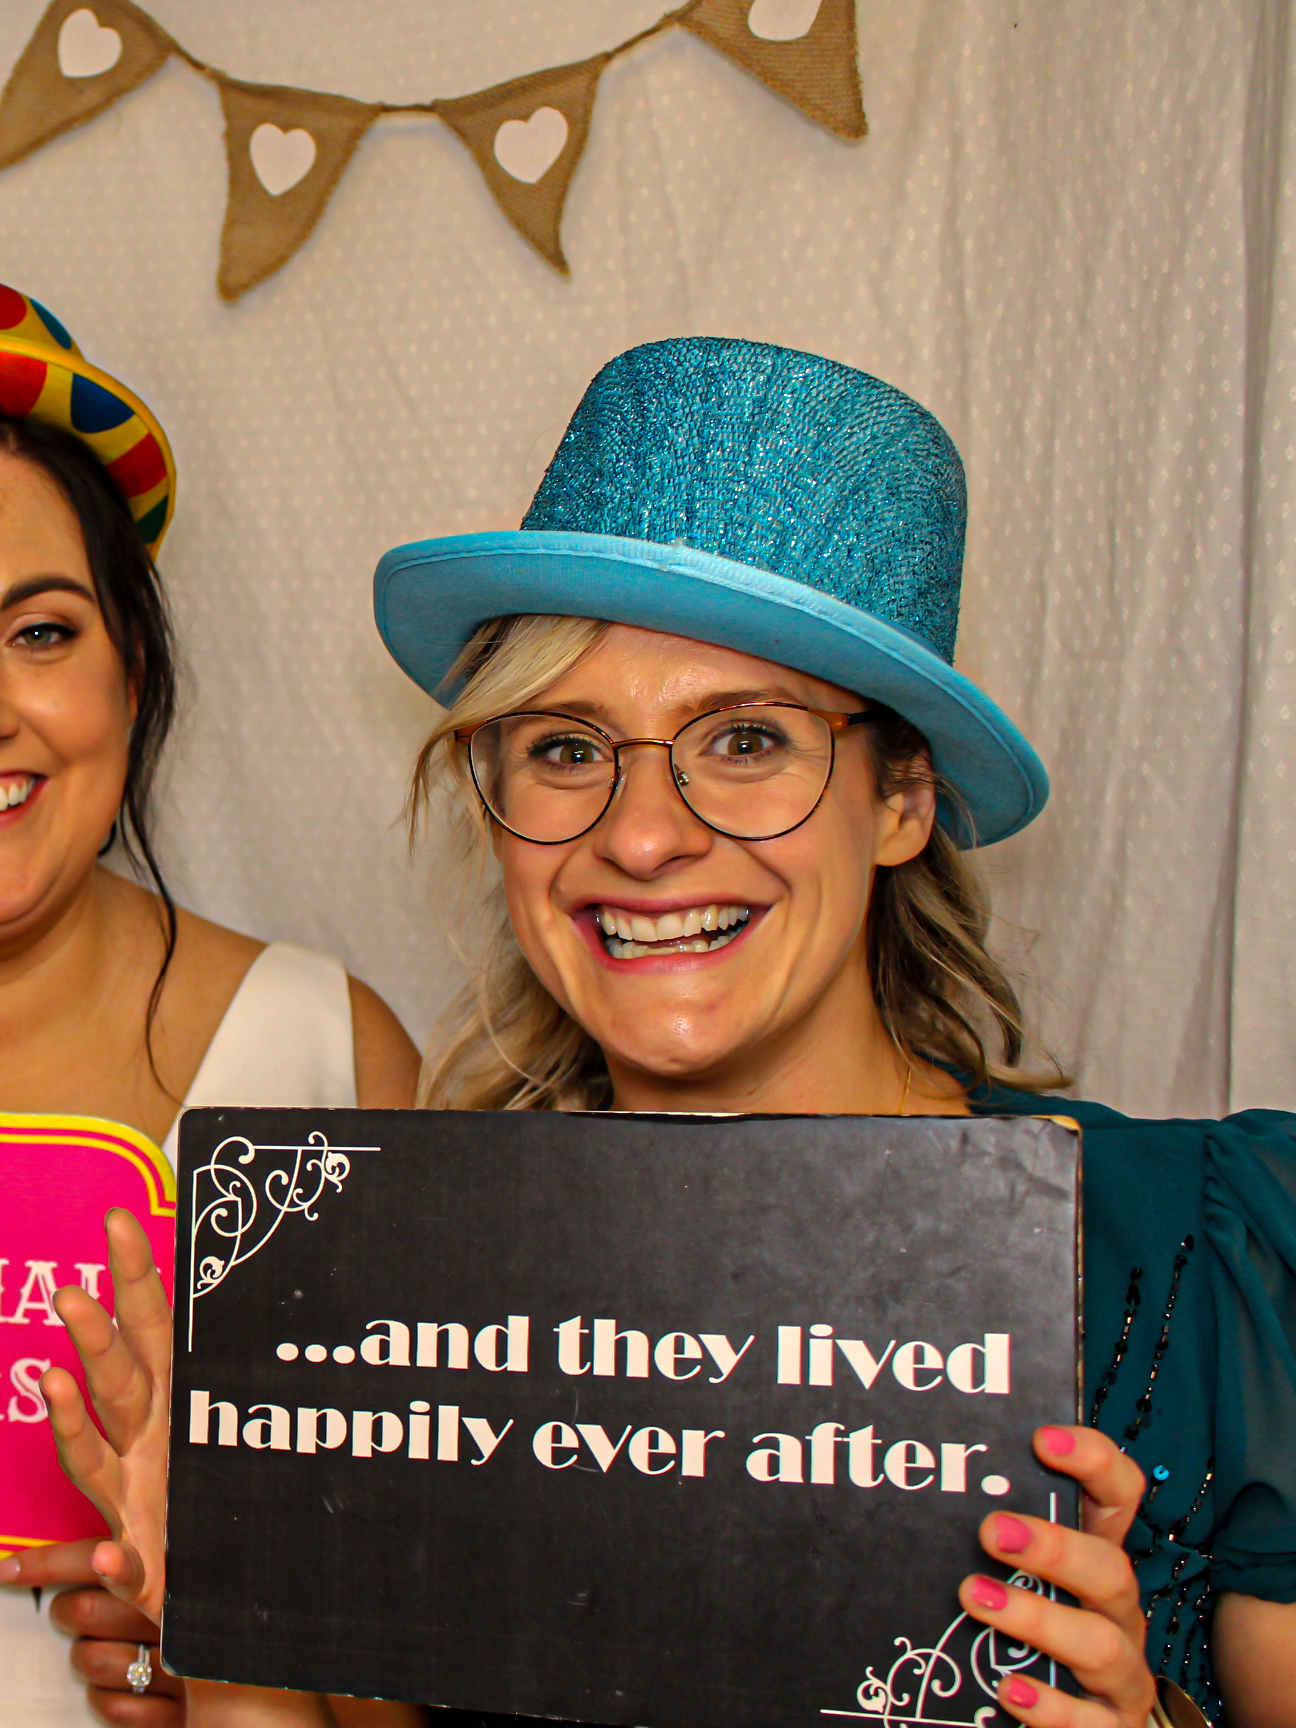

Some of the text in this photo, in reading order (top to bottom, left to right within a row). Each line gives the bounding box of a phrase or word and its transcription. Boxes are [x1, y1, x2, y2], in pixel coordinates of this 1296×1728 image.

[552, 1315, 755, 1384] they
[776, 1323, 1011, 1395] lived
[188, 1389, 1011, 1496] happily ever after.
